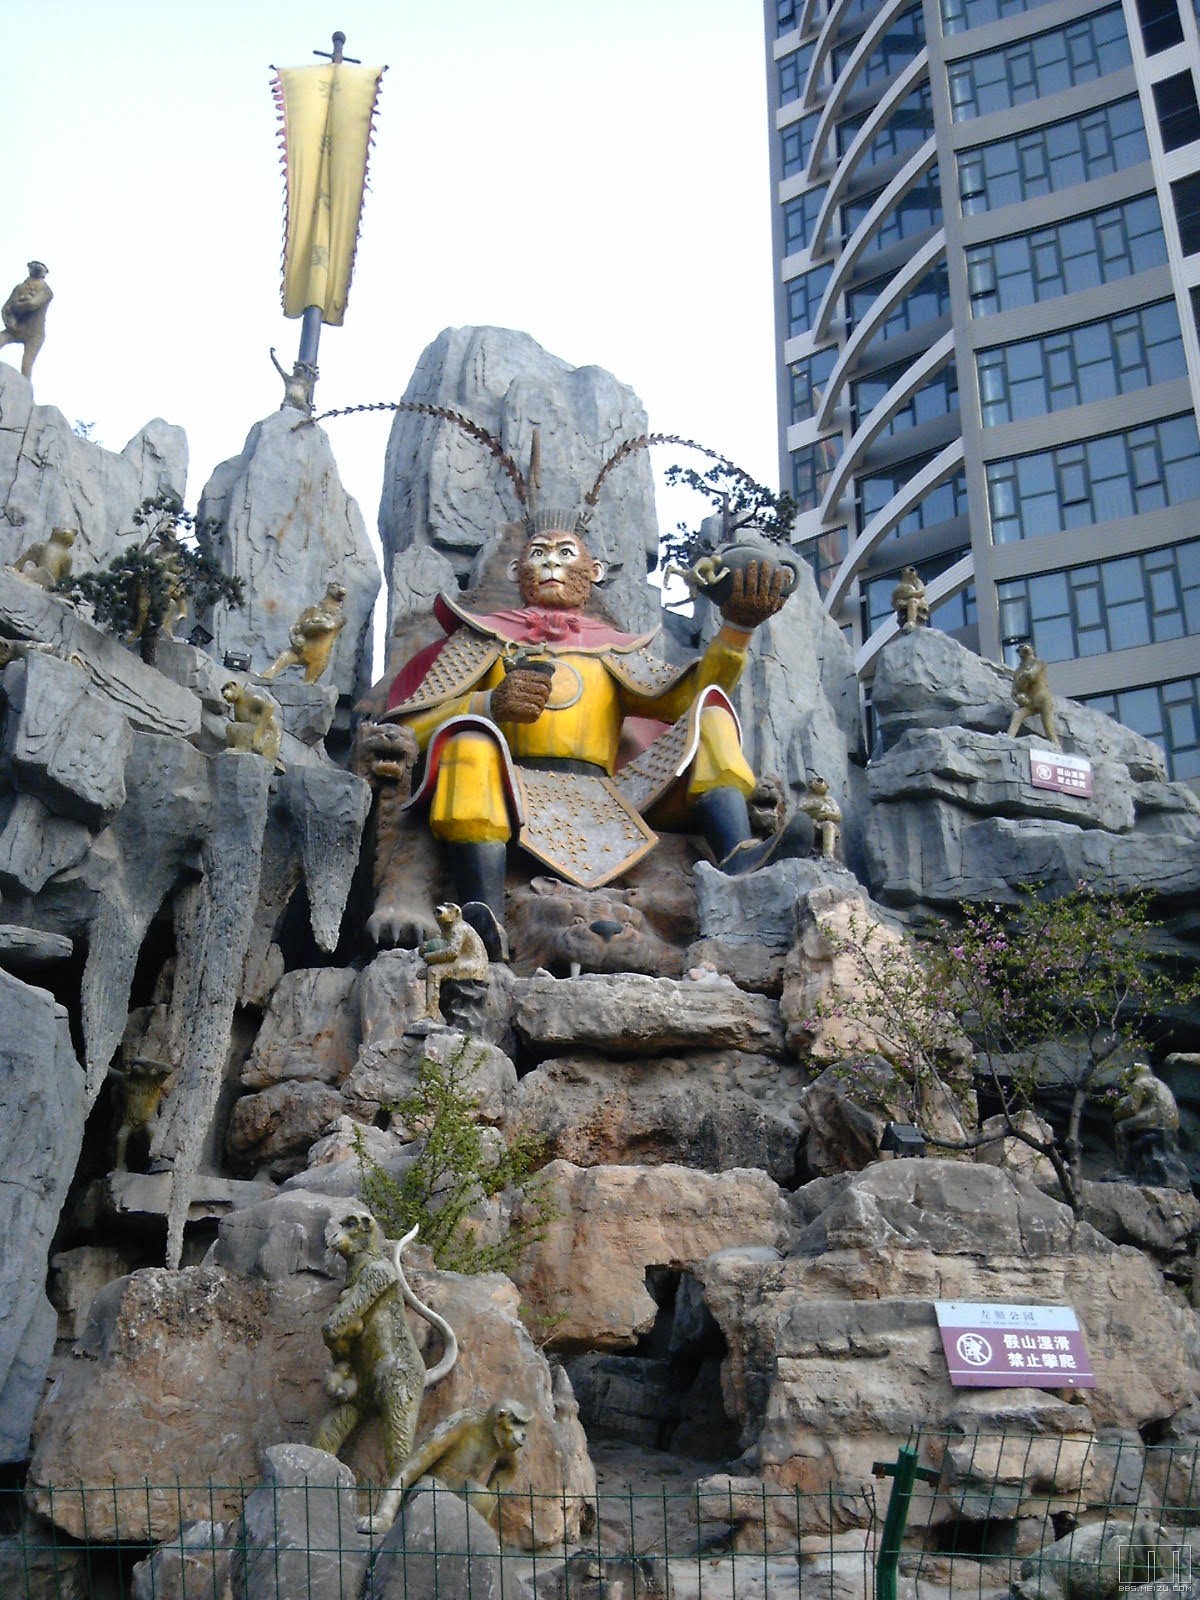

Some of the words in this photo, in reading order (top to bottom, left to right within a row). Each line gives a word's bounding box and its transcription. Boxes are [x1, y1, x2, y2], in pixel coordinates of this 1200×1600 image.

[1003, 1334, 1070, 1351] 假山湿滑
[1008, 1352, 1077, 1369] 禁止攀爬
